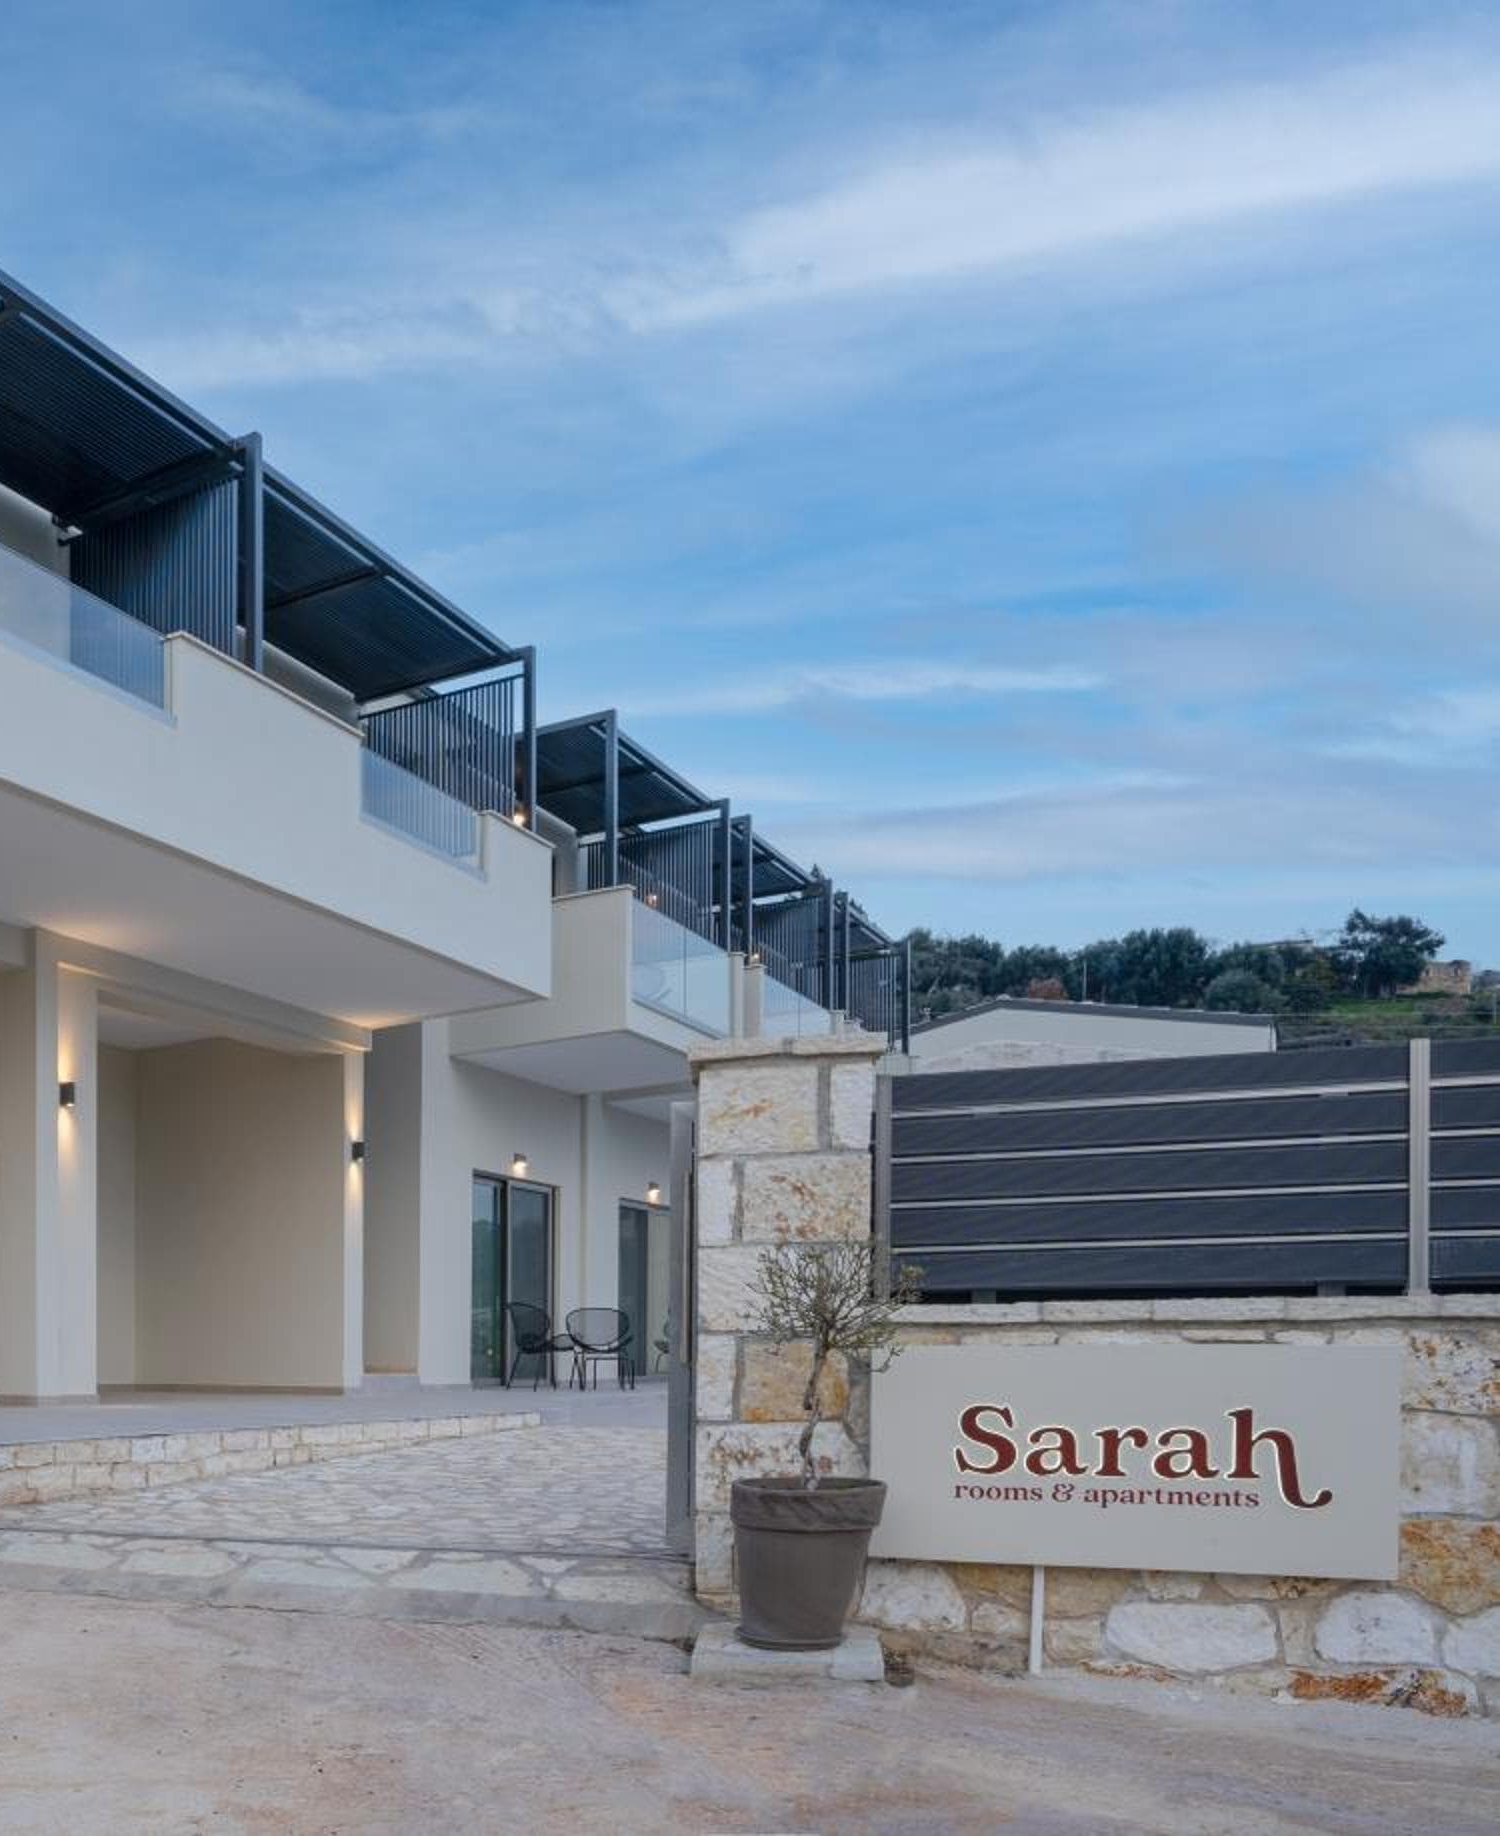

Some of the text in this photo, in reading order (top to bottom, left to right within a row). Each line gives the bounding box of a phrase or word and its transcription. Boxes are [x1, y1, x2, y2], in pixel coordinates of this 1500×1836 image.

[954, 1403, 1333, 1510] Sarah
[954, 1483, 1260, 1509] rooms & apartments
